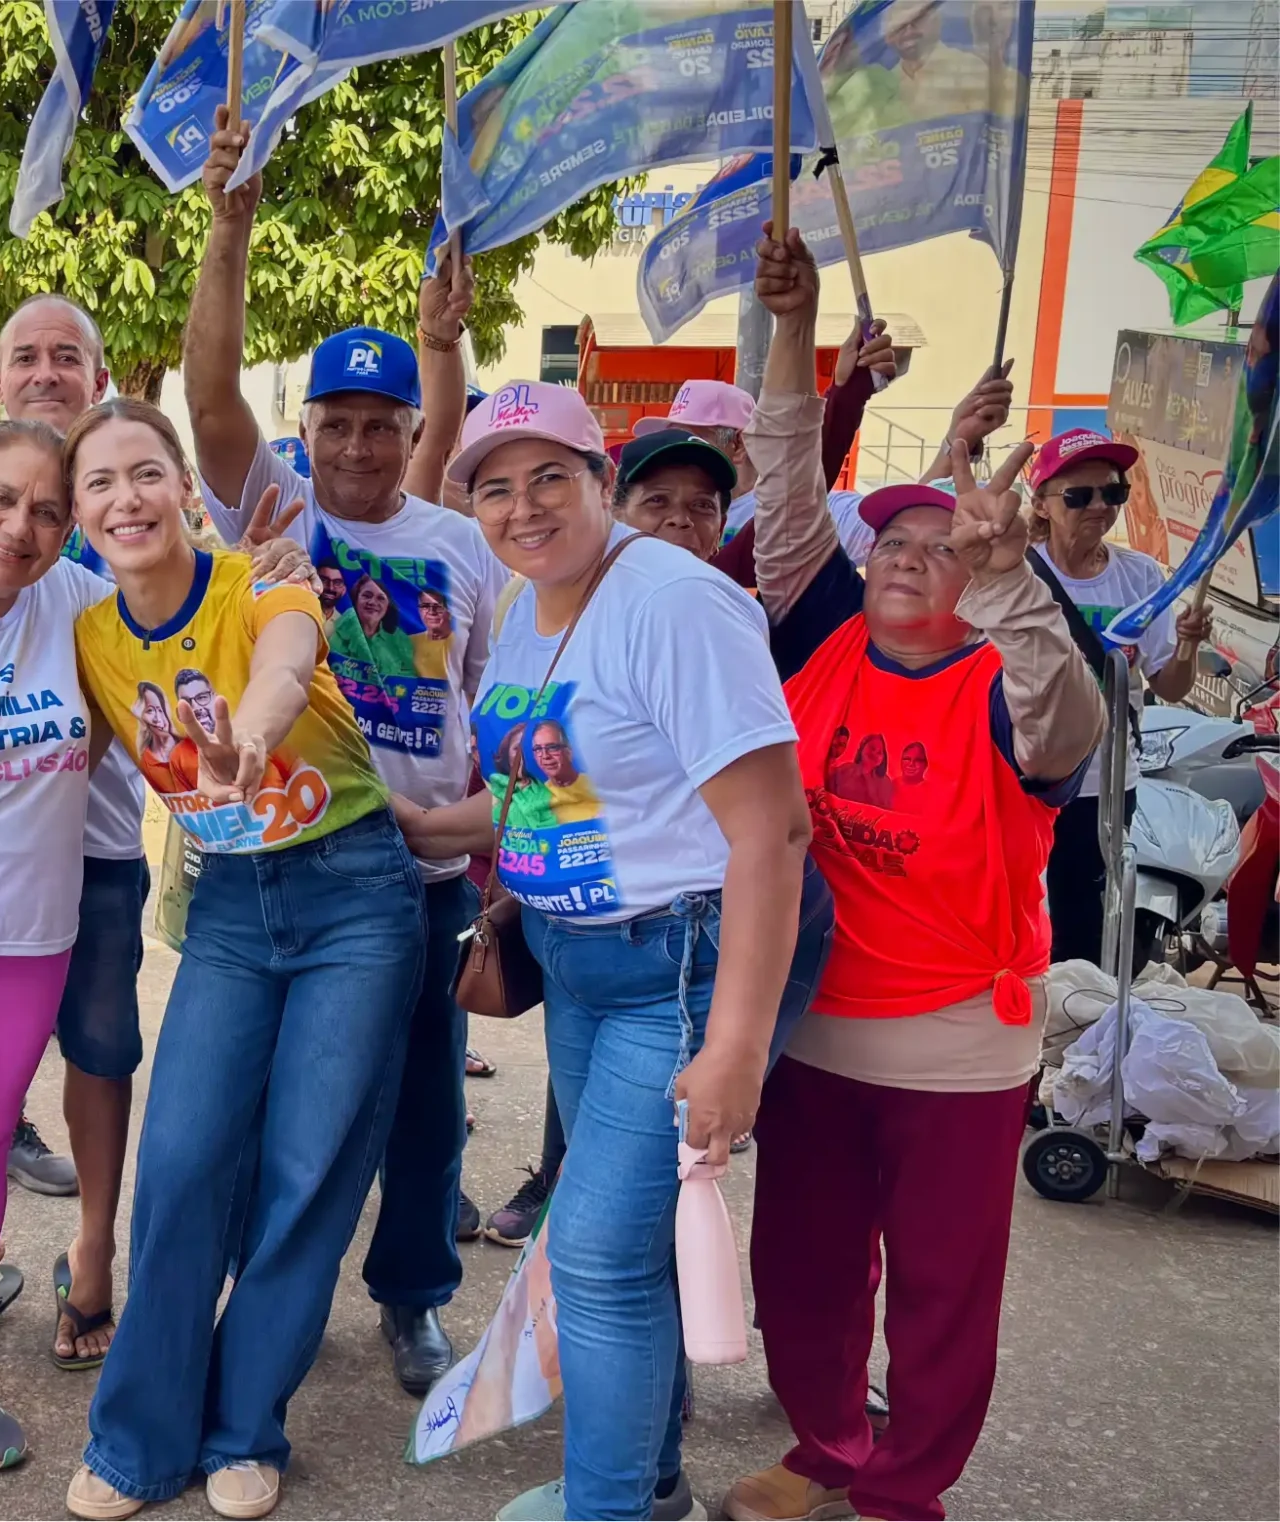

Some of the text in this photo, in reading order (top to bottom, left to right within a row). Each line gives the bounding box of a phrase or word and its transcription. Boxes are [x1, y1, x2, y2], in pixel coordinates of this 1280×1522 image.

[349, 348, 378, 369] PL
[491, 384, 539, 422] PL
[411, 701, 447, 715] 2222
[69, 716, 87, 740] &
[425, 733, 439, 746] PL
[165, 793, 213, 815] UTOR
[253, 769, 328, 843] 20
[173, 803, 265, 843] NIEL
[501, 836, 539, 854] LEIDA
[557, 834, 608, 847] JOAQUIM
[557, 841, 610, 855] PASSARINHO
[499, 847, 546, 877] .245
[559, 849, 612, 869] 2222
[527, 886, 587, 912] GENTE!
[589, 885, 615, 903] PL
